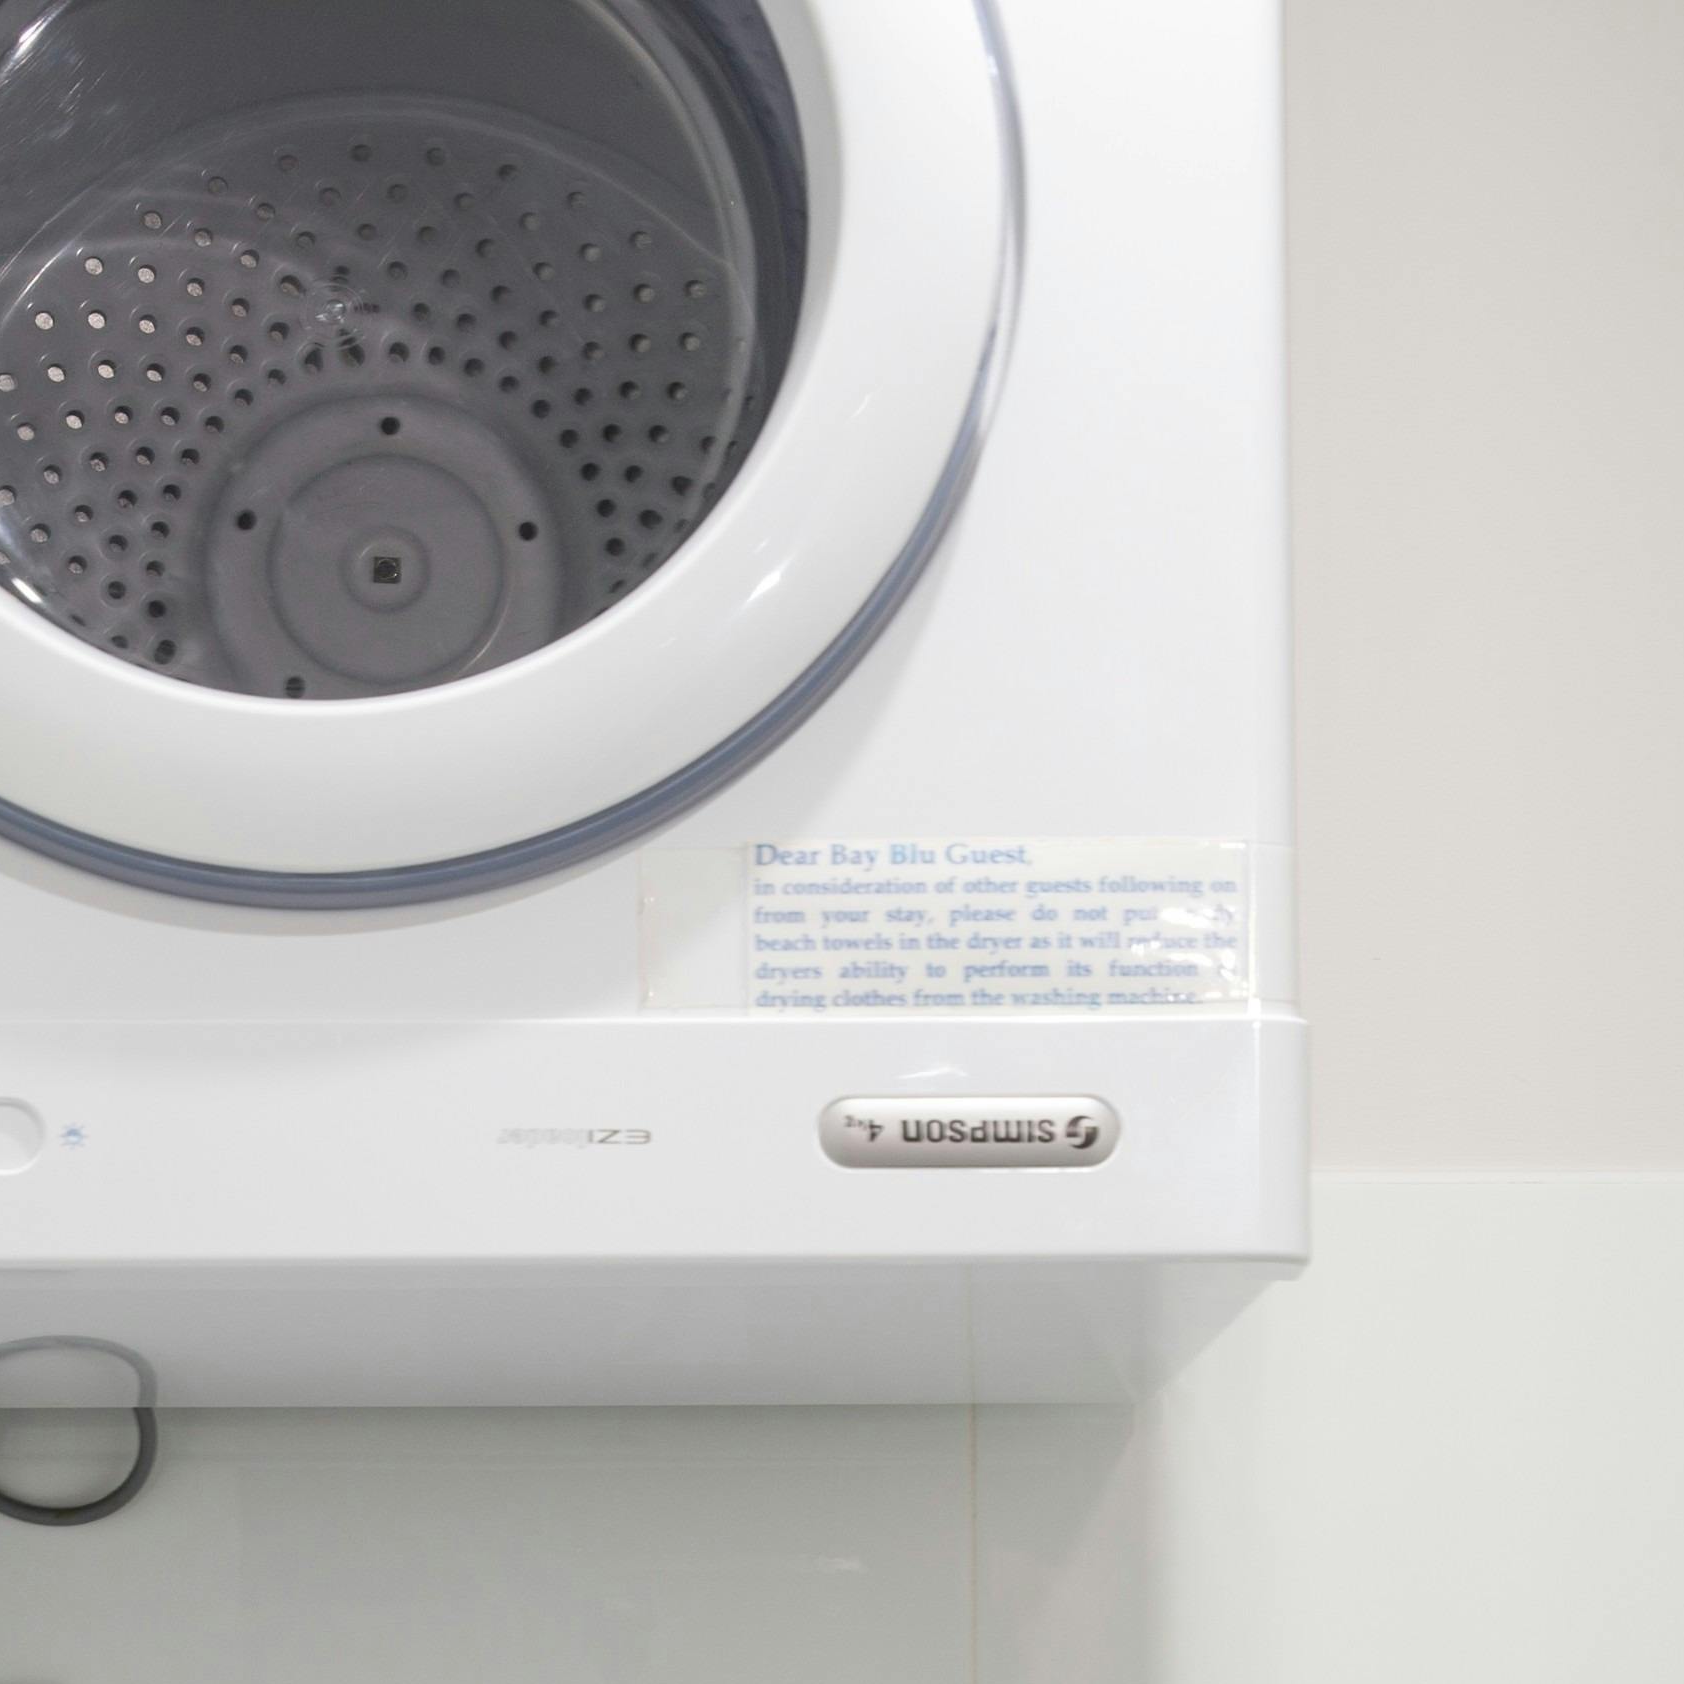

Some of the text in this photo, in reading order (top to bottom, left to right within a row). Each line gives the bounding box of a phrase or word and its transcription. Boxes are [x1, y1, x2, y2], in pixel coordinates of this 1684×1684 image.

[754, 843, 822, 866] Dear
[829, 843, 880, 871] Bay
[889, 843, 936, 865] Blu
[753, 876, 1237, 898] in consideration of other guests following on
[753, 906, 806, 924] from
[821, 910, 870, 928] your
[948, 905, 1017, 927] please
[1030, 904, 1059, 922] do
[1072, 906, 1108, 921] not
[754, 934, 816, 952] beach
[822, 934, 893, 951] towels
[899, 933, 921, 951] in
[926, 932, 961, 951] the
[966, 932, 1022, 955] dryer
[1029, 935, 1051, 950] as
[1057, 932, 1072, 950] it
[1079, 931, 1121, 949] will
[1203, 932, 1237, 949] the
[754, 961, 823, 985] dryers
[838, 960, 908, 984] ability
[924, 962, 947, 979] to
[962, 960, 1050, 983] perform
[1066, 960, 1093, 977] its
[1107, 959, 1199, 977] function
[754, 988, 827, 1012] drying
[831, 988, 907, 1008] clothes
[912, 988, 965, 1006] from
[971, 988, 1004, 1006] the
[1010, 988, 1103, 1009] washing
[901, 1119, 1056, 1144] SIMPSON
